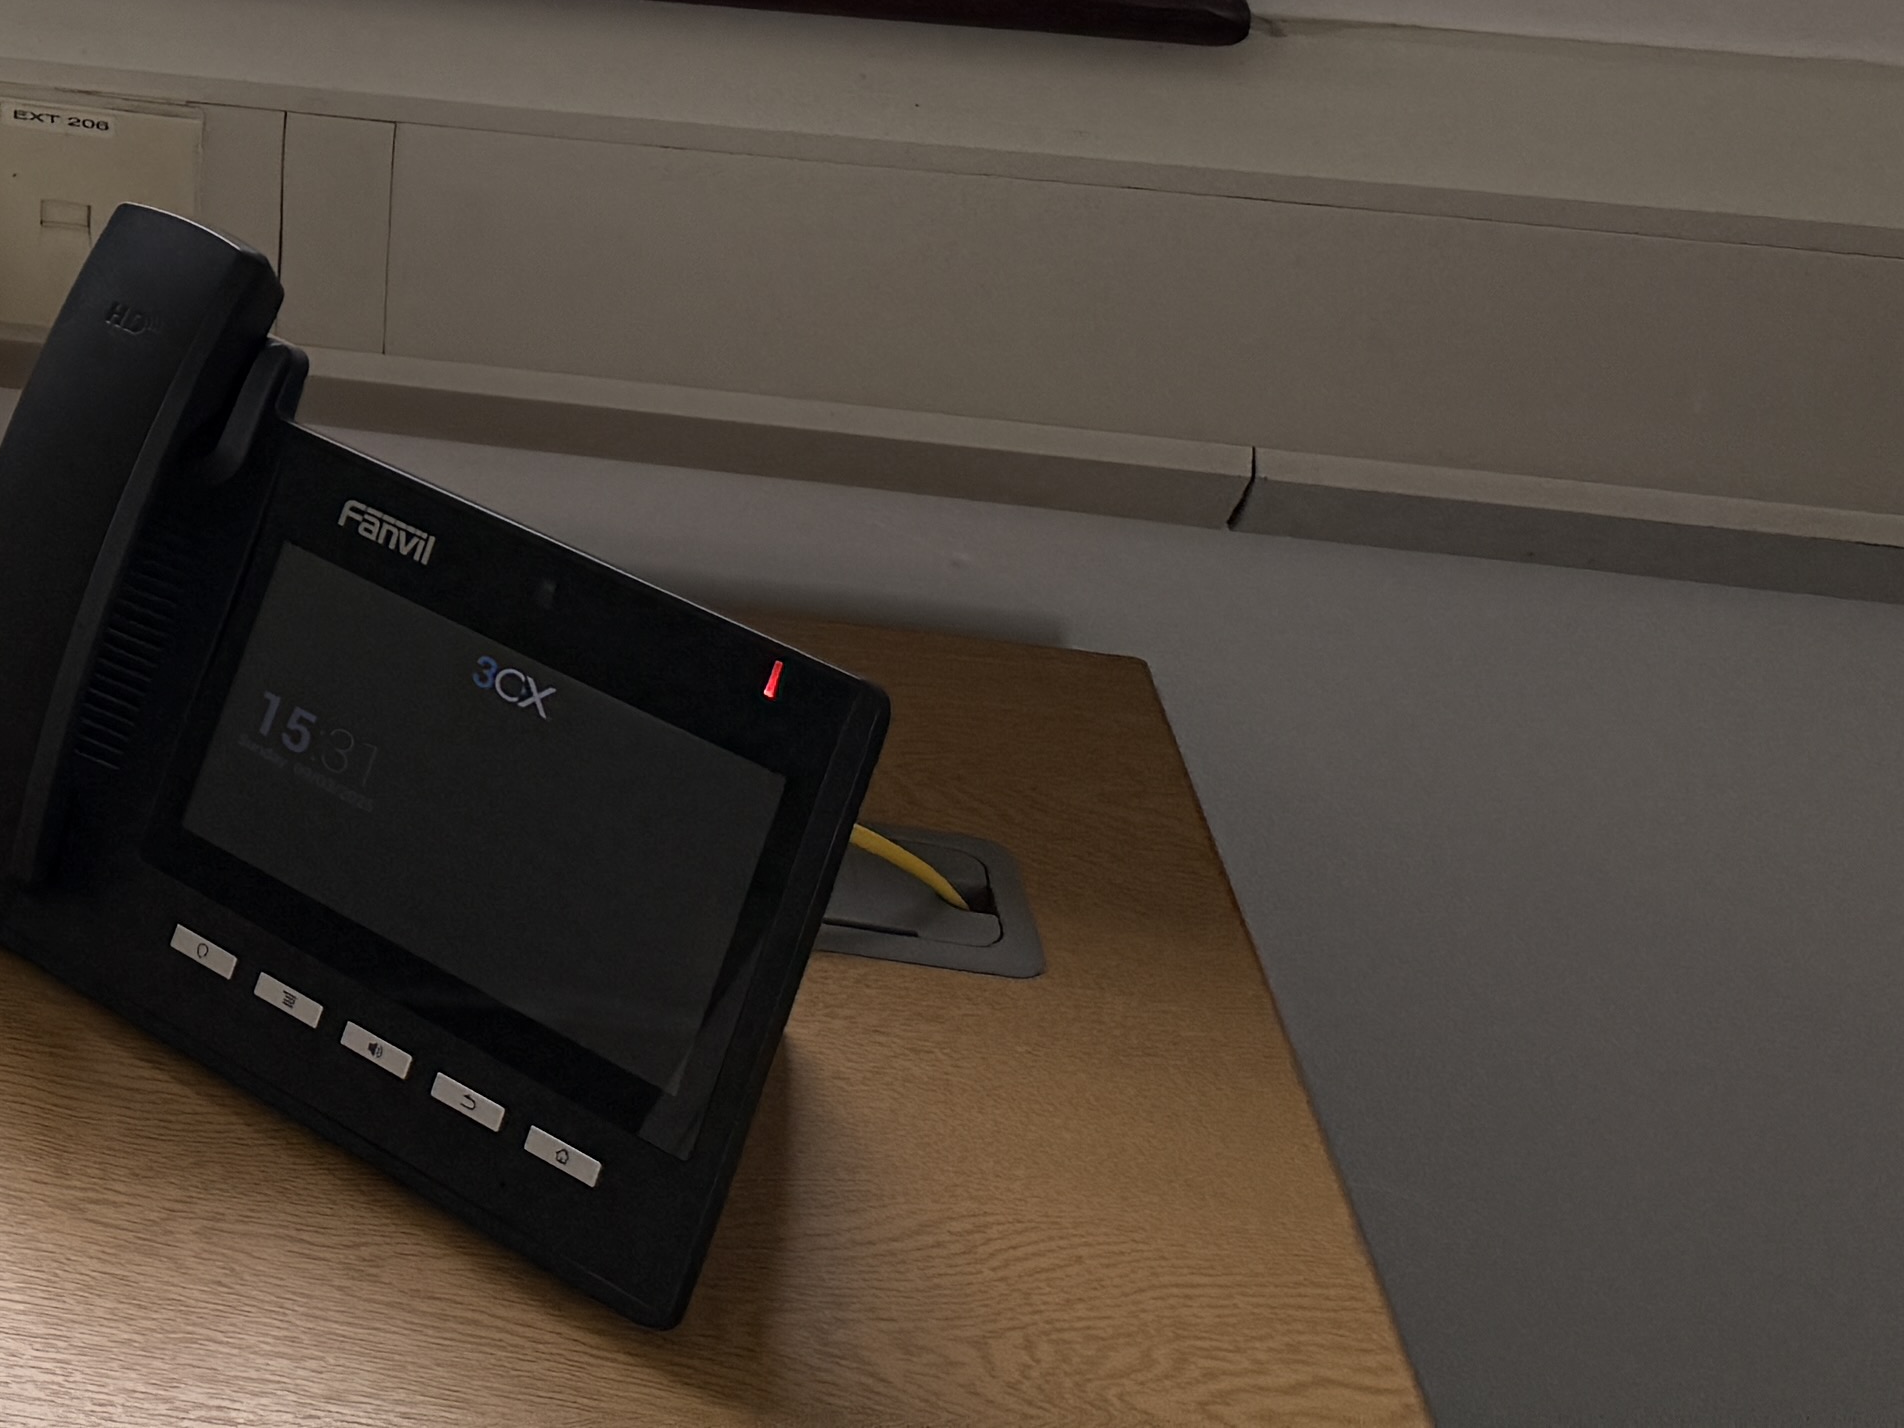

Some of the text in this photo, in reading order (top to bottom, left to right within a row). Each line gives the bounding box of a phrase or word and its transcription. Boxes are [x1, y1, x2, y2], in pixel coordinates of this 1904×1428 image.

[13, 109, 60, 124] EXT
[337, 499, 437, 567] Fanvil
[472, 655, 559, 720] 3CX
[259, 690, 378, 787] 15:31
